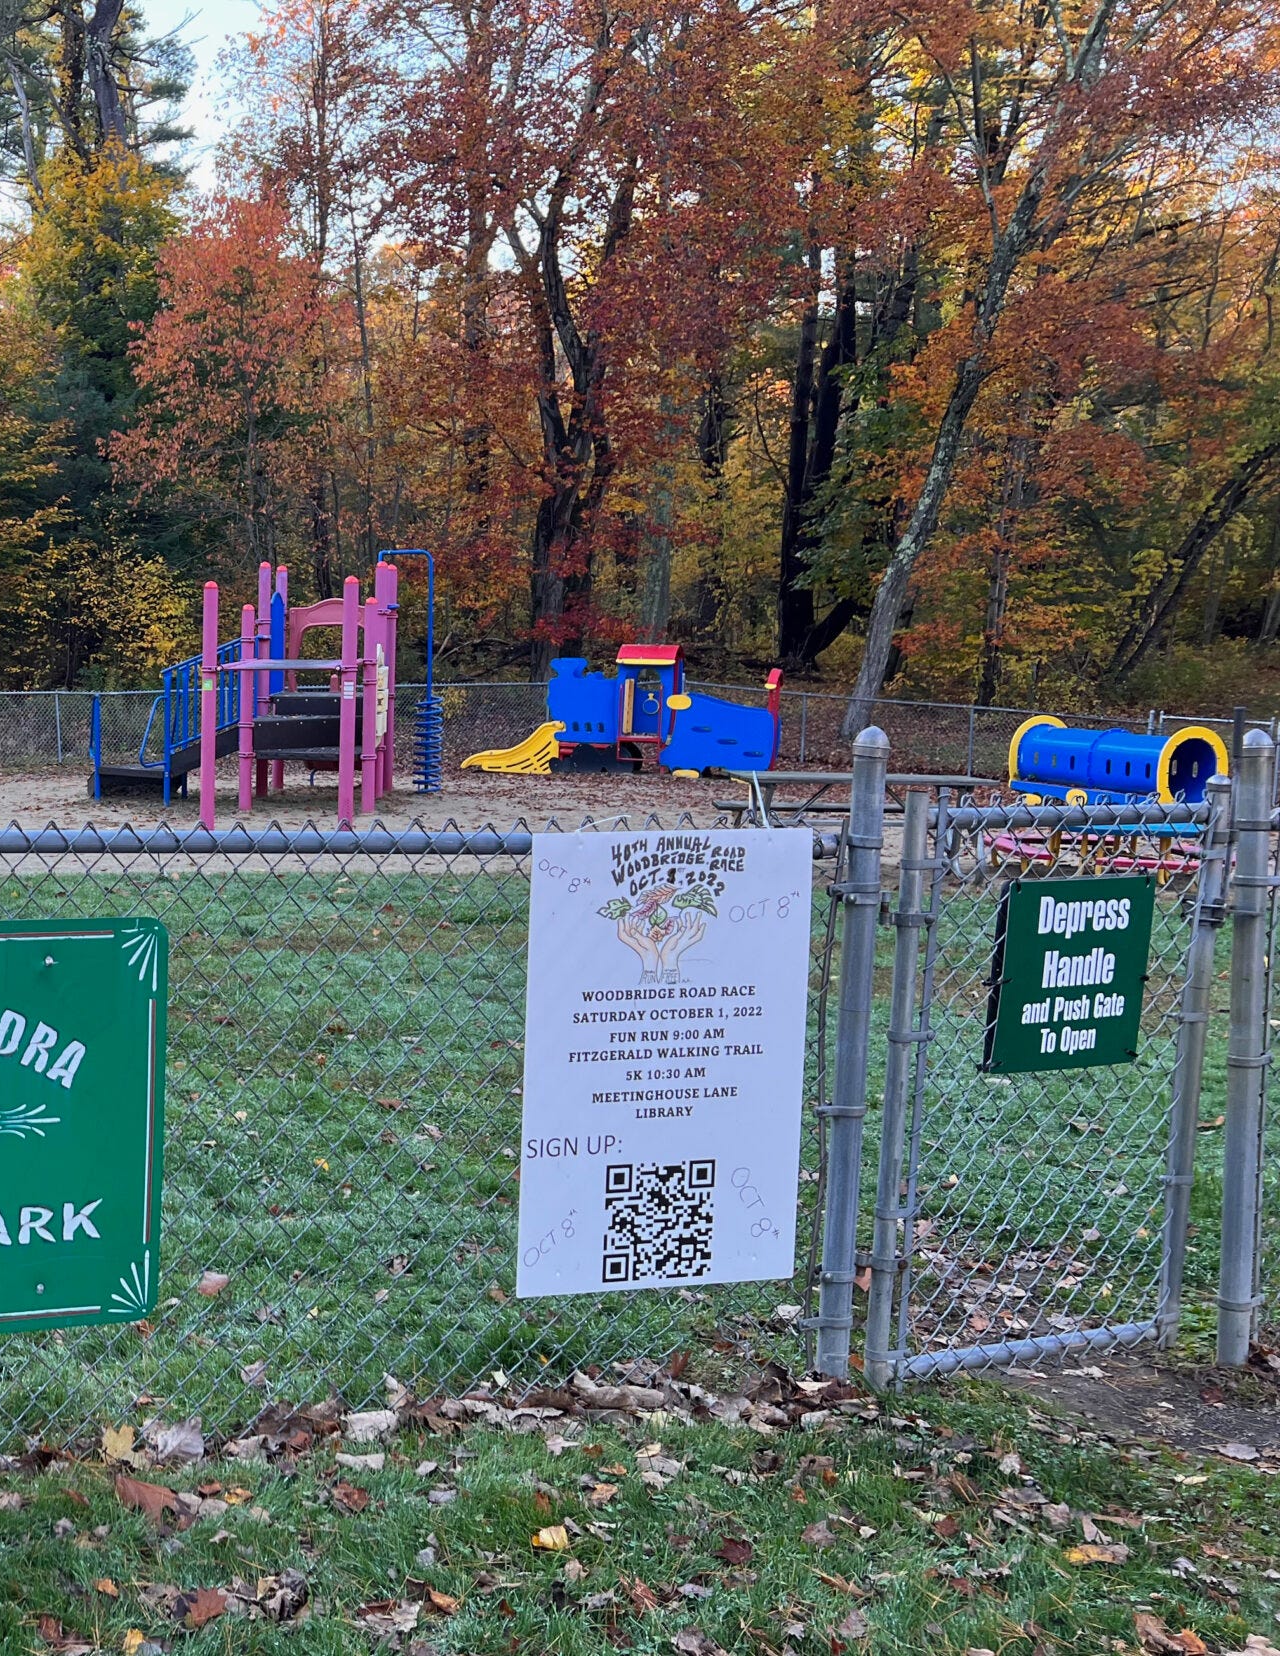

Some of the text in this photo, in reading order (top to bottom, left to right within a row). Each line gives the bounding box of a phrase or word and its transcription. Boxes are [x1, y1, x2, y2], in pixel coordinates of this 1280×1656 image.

[611, 835, 712, 868] 40TH ANNUAL
[710, 846, 746, 859] ROAD
[538, 858, 568, 879] OCT
[709, 858, 745, 872] RACE
[728, 898, 770, 923] OCT
[1038, 896, 1131, 939] Depress
[1041, 947, 1116, 989] Handle
[582, 985, 756, 1002] WOODBRIDGE ROAD RACE
[573, 1006, 763, 1024] SATURDAY OCTOBER 1, 2022
[1021, 992, 1125, 1024] and Push Gate
[609, 1027, 726, 1043] FUN RUN 9:00 AM
[1040, 1026, 1096, 1055] To Open
[568, 1044, 764, 1063] FITZGERALD WALKING TRAIL
[625, 1067, 707, 1081] 5K 10:30 AM
[592, 1086, 738, 1103] MEETINGHOUSE LANE
[635, 1106, 694, 1119] LIBRARY
[526, 1134, 622, 1159] SIGN UP:
[730, 1167, 765, 1208] OCT
[523, 1228, 556, 1267] OCT
